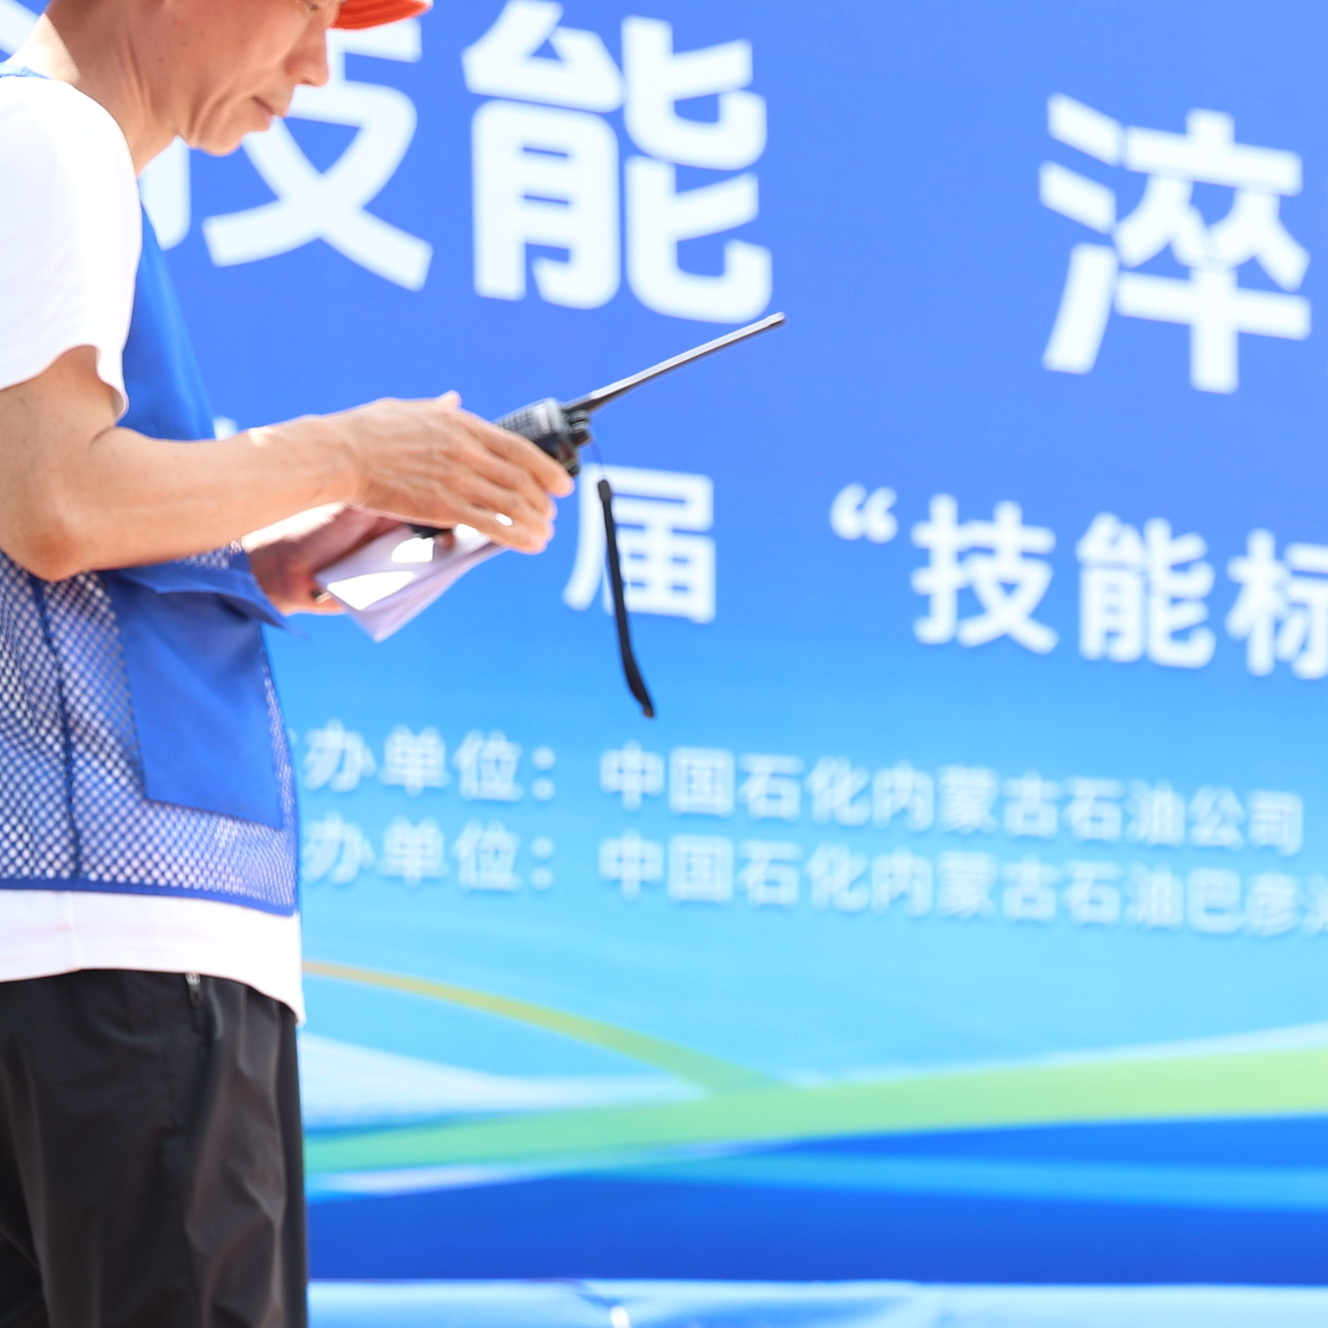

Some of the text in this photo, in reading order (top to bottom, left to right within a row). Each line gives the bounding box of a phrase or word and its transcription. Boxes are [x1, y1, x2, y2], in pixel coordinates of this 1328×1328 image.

[0, 0, 773, 323] 技能
[562, 462, 717, 625] 届
[298, 718, 557, 801] 办单位：
[298, 812, 556, 891] 办单位：
